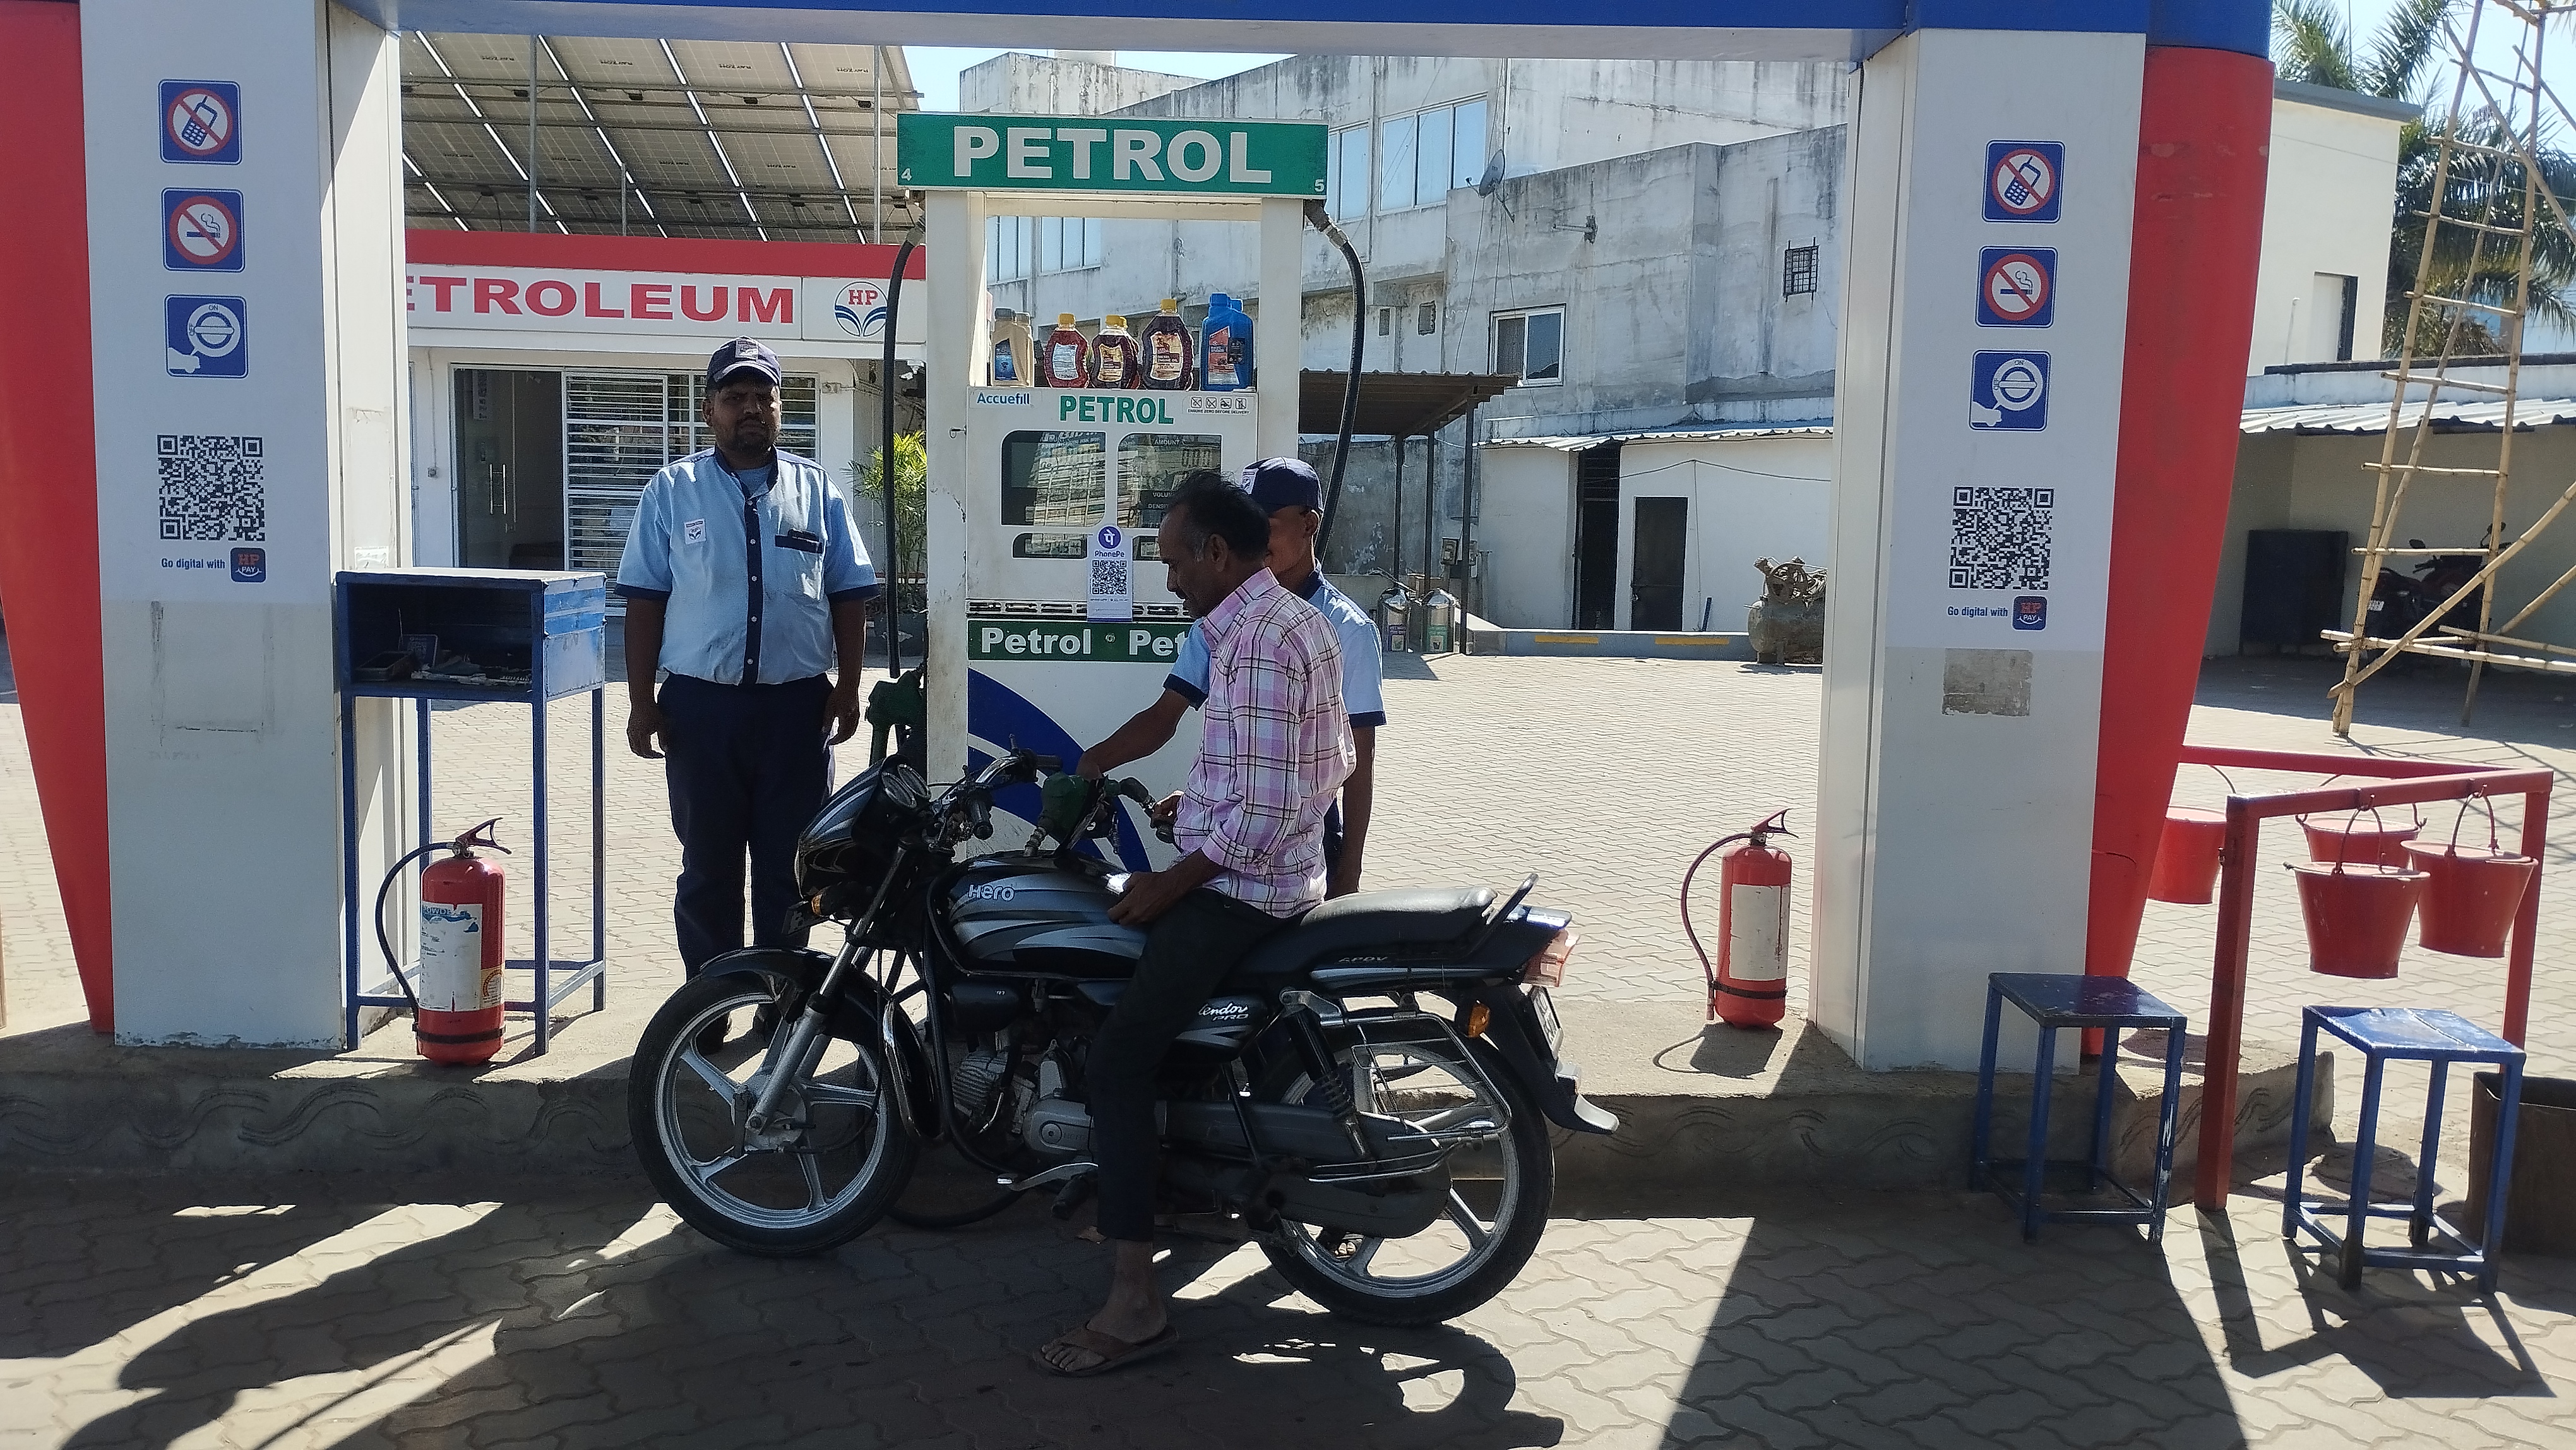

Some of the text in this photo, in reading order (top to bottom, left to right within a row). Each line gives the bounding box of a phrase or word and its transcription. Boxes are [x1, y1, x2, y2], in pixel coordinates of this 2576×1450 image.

[954, 126, 1272, 183] PETROL
[901, 168, 912, 181] 4
[1315, 179, 1324, 192] 5
[407, 276, 793, 323] TROLEUM
[848, 289, 878, 305] HP
[977, 393, 1029, 404] Accuefill
[1060, 395, 1174, 424] PETROL
[162, 558, 225, 570] Go digital with
[238, 554, 259, 565] HP
[1948, 606, 2008, 618] Go digital with
[981, 628, 1091, 654] Petrol
[969, 884, 1014, 901] Hero
